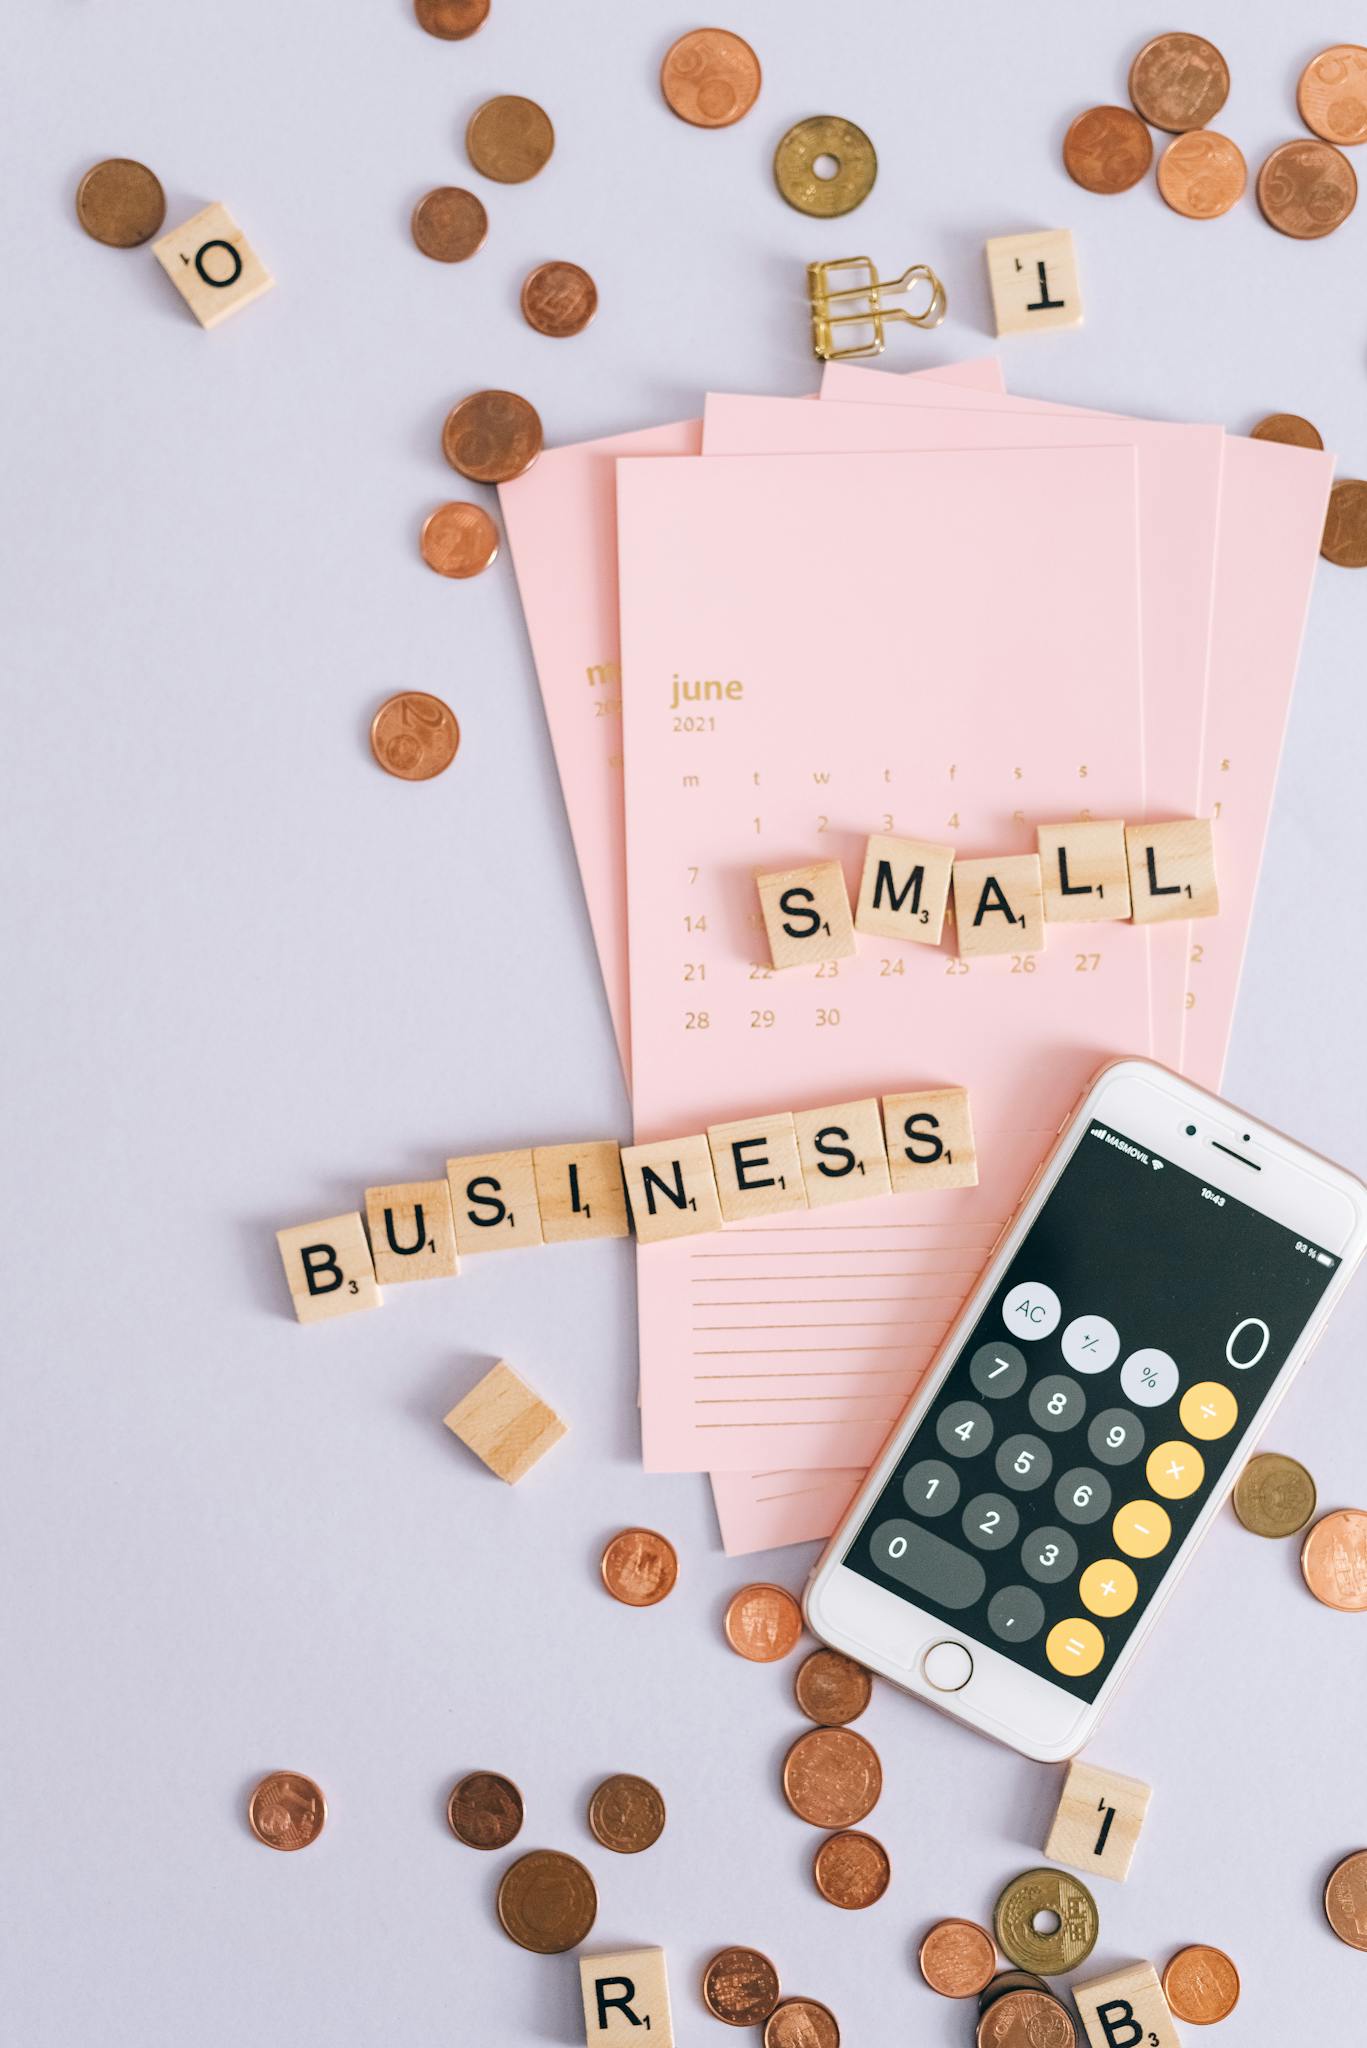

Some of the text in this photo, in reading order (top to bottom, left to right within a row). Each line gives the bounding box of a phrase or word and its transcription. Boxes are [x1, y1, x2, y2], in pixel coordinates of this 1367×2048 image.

[194, 239, 243, 288] O
[1026, 261, 1065, 312] T
[670, 671, 745, 710] june
[672, 716, 718, 733] 2021
[682, 764, 1089, 788] m t w t f s s
[753, 816, 762, 834] 1
[817, 815, 829, 834] 2
[882, 813, 895, 832] 3
[947, 811, 961, 830] 4
[687, 866, 700, 885] 7
[683, 914, 708, 933] 14
[683, 963, 707, 982] 21
[814, 959, 840, 978] 23
[879, 957, 906, 977] 24
[945, 957, 970, 975] 25
[1010, 954, 1037, 974] 26
[1075, 952, 1101, 972] 27
[684, 1008, 841, 1030] 28 29 30
[1104, 1132, 1150, 1166] MASMOVIL
[1200, 1186, 1227, 1208] 10:43
[1294, 1240, 1309, 1255] 93
[1015, 1299, 1046, 1324] AC
[1225, 1317, 1271, 1370] 0
[987, 1357, 1010, 1380] 7
[1046, 1392, 1068, 1416] 8
[1105, 1425, 1127, 1449] 9
[954, 1420, 976, 1442] 4
[1013, 1450, 1036, 1475] 5
[1072, 1485, 1094, 1508] 6
[924, 1478, 940, 1500] 1
[978, 1510, 1001, 1535] 2
[1038, 1543, 1060, 1567] 3
[887, 1535, 908, 1559] 0
[594, 1976, 643, 2031] R
[1095, 1998, 1144, 2048] B
